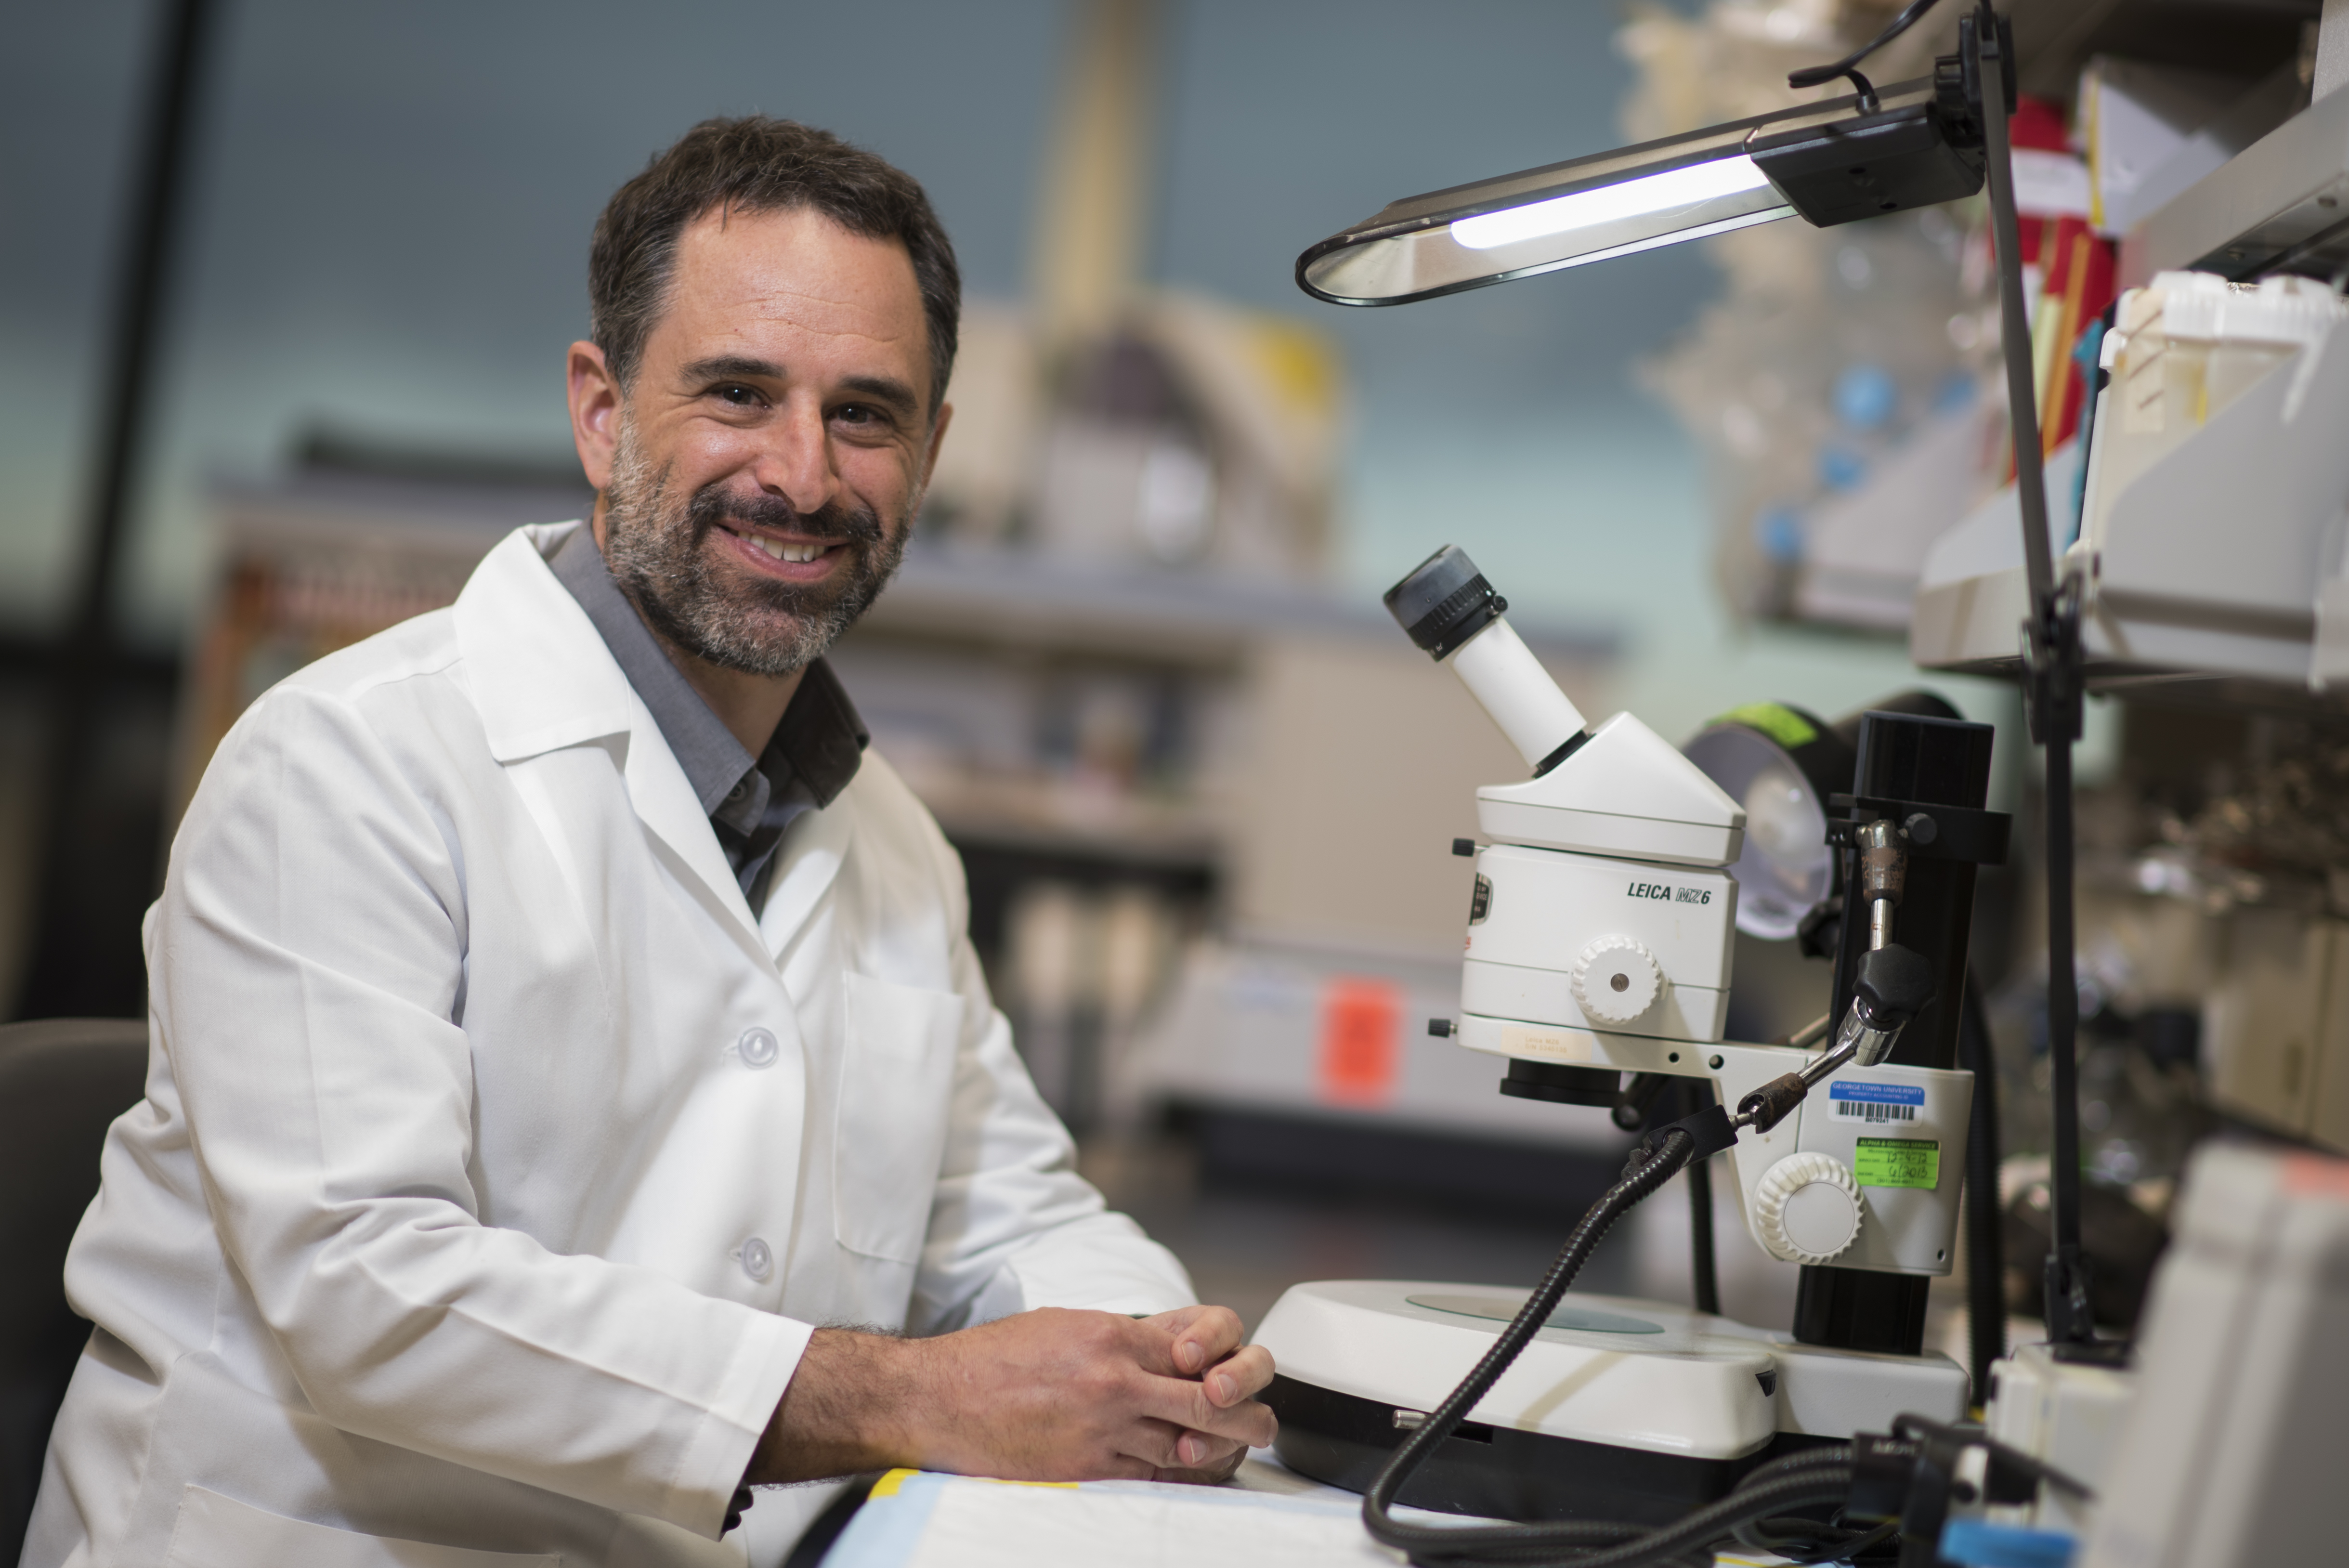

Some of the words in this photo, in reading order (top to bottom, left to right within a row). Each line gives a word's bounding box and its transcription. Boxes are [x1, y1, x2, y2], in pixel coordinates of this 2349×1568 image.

[1627, 882, 1671, 901] LEICA
[1525, 1035, 1543, 1044] Leica
[1833, 1083, 1881, 1092] GEORGETOWN
[1883, 1086, 1922, 1095] UNIVERSITY
